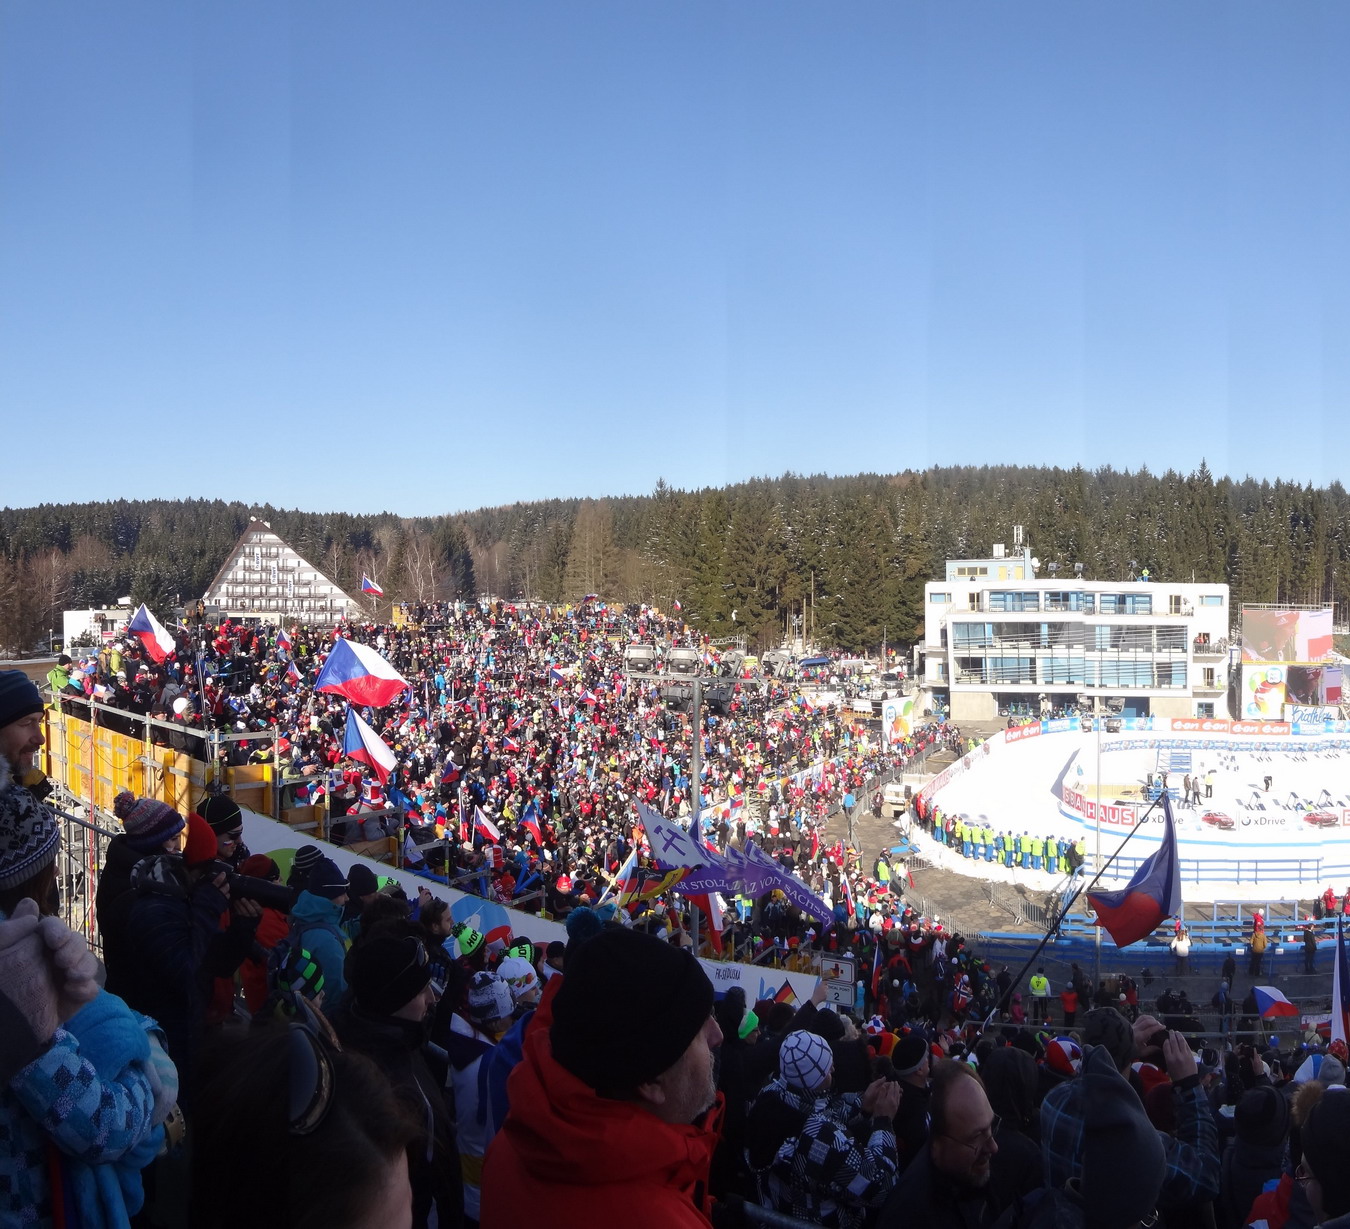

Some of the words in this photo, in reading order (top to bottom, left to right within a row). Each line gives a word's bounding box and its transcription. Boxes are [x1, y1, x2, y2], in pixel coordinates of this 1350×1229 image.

[1152, 815, 1184, 826] xDve
[1254, 815, 1286, 826] xDrive
[834, 993, 840, 1002] 2
